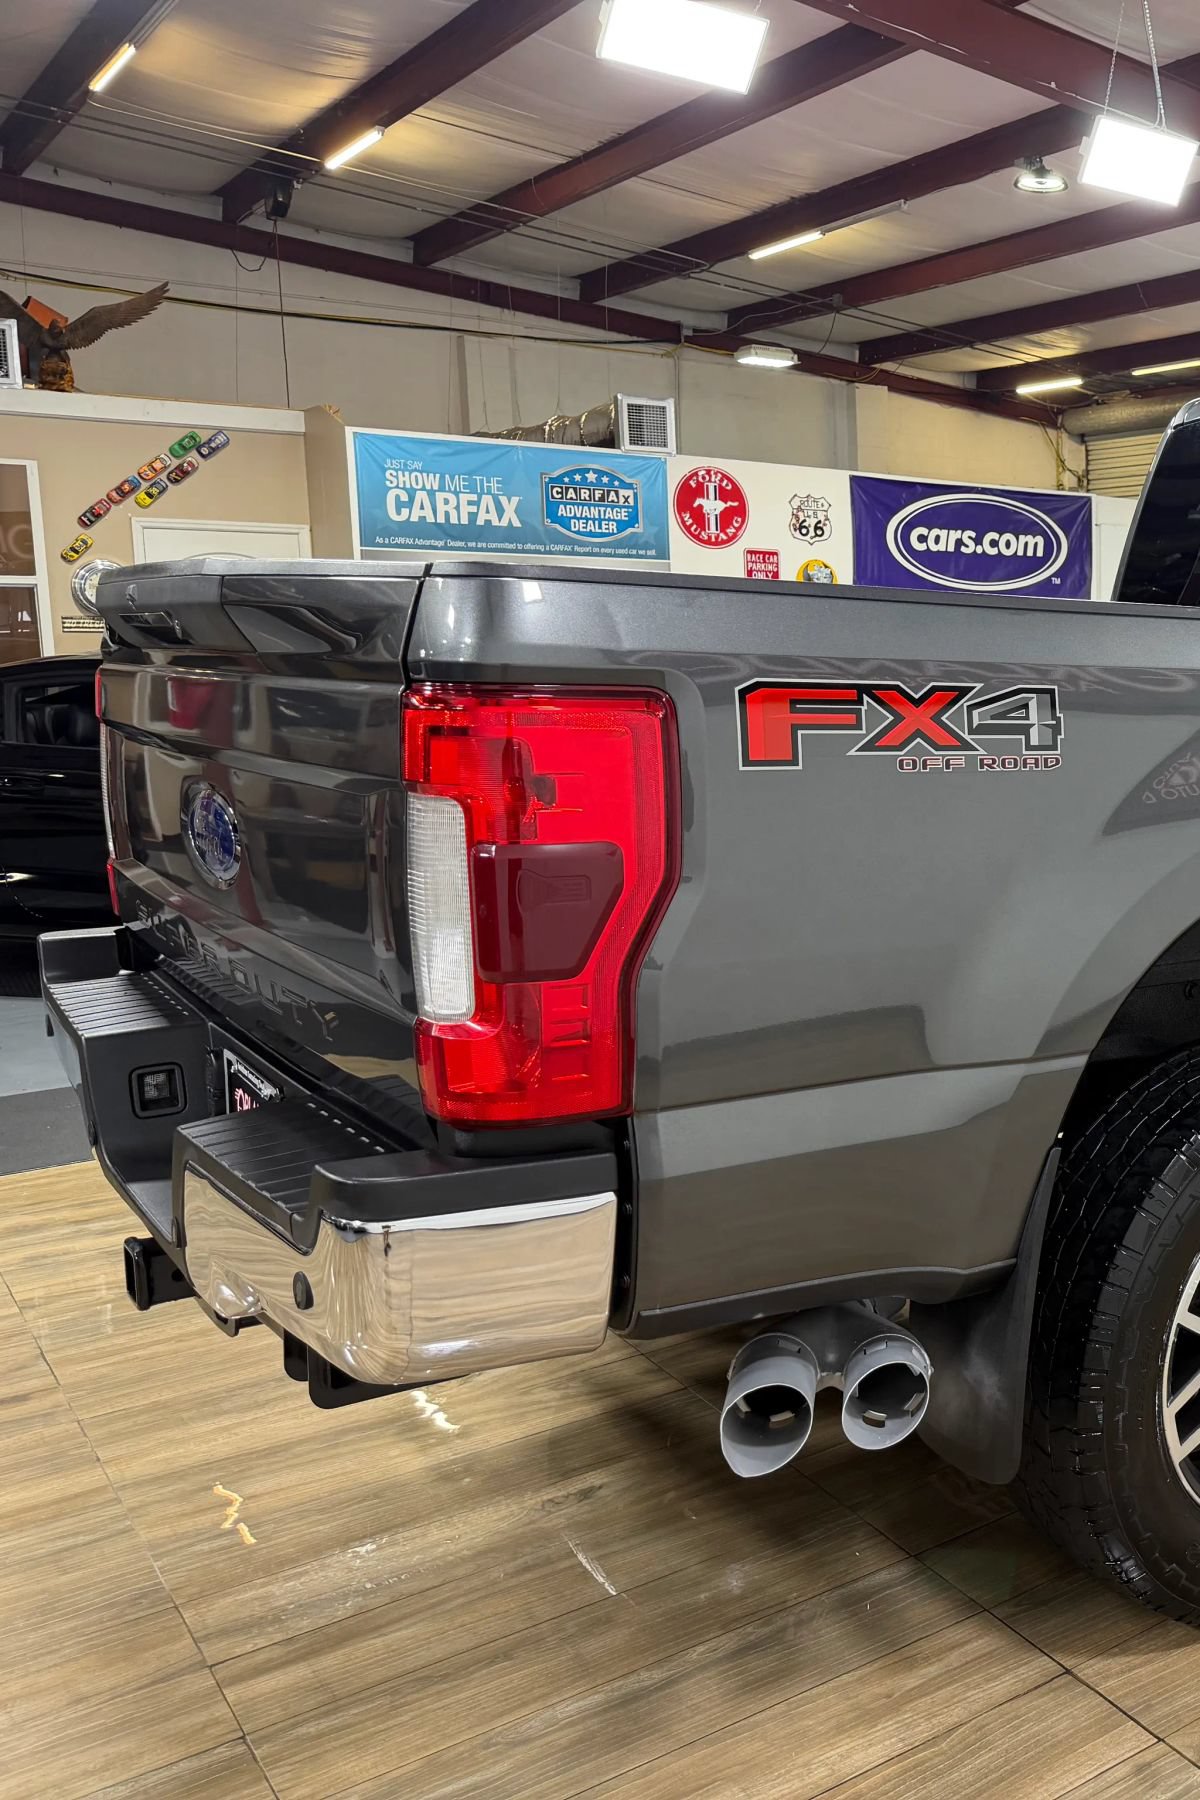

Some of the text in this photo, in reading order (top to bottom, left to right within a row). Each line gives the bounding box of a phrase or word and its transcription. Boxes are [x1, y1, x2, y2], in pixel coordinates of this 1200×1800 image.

[384, 459, 423, 470] JUST SAY
[385, 470, 504, 494] SHOW ME THE
[688, 469, 733, 490] FORD
[552, 486, 631, 504] CARFAX
[800, 499, 820, 508] ROUTE
[386, 488, 522, 528] CARFAX
[557, 504, 629, 520] ADVANTAGE
[570, 518, 617, 533] DEALER
[681, 511, 742, 542] MUSTANG
[799, 519, 825, 538] 66
[390, 536, 414, 544] CARFAX
[487, 541, 516, 549] committed
[909, 526, 1045, 557] cars.com
[747, 553, 778, 563] RACE CAR
[747, 562, 778, 572] PARKING
[752, 571, 773, 579] ONLY
[735, 678, 1064, 770] FX4
[897, 755, 1062, 773] OFF ROAD
